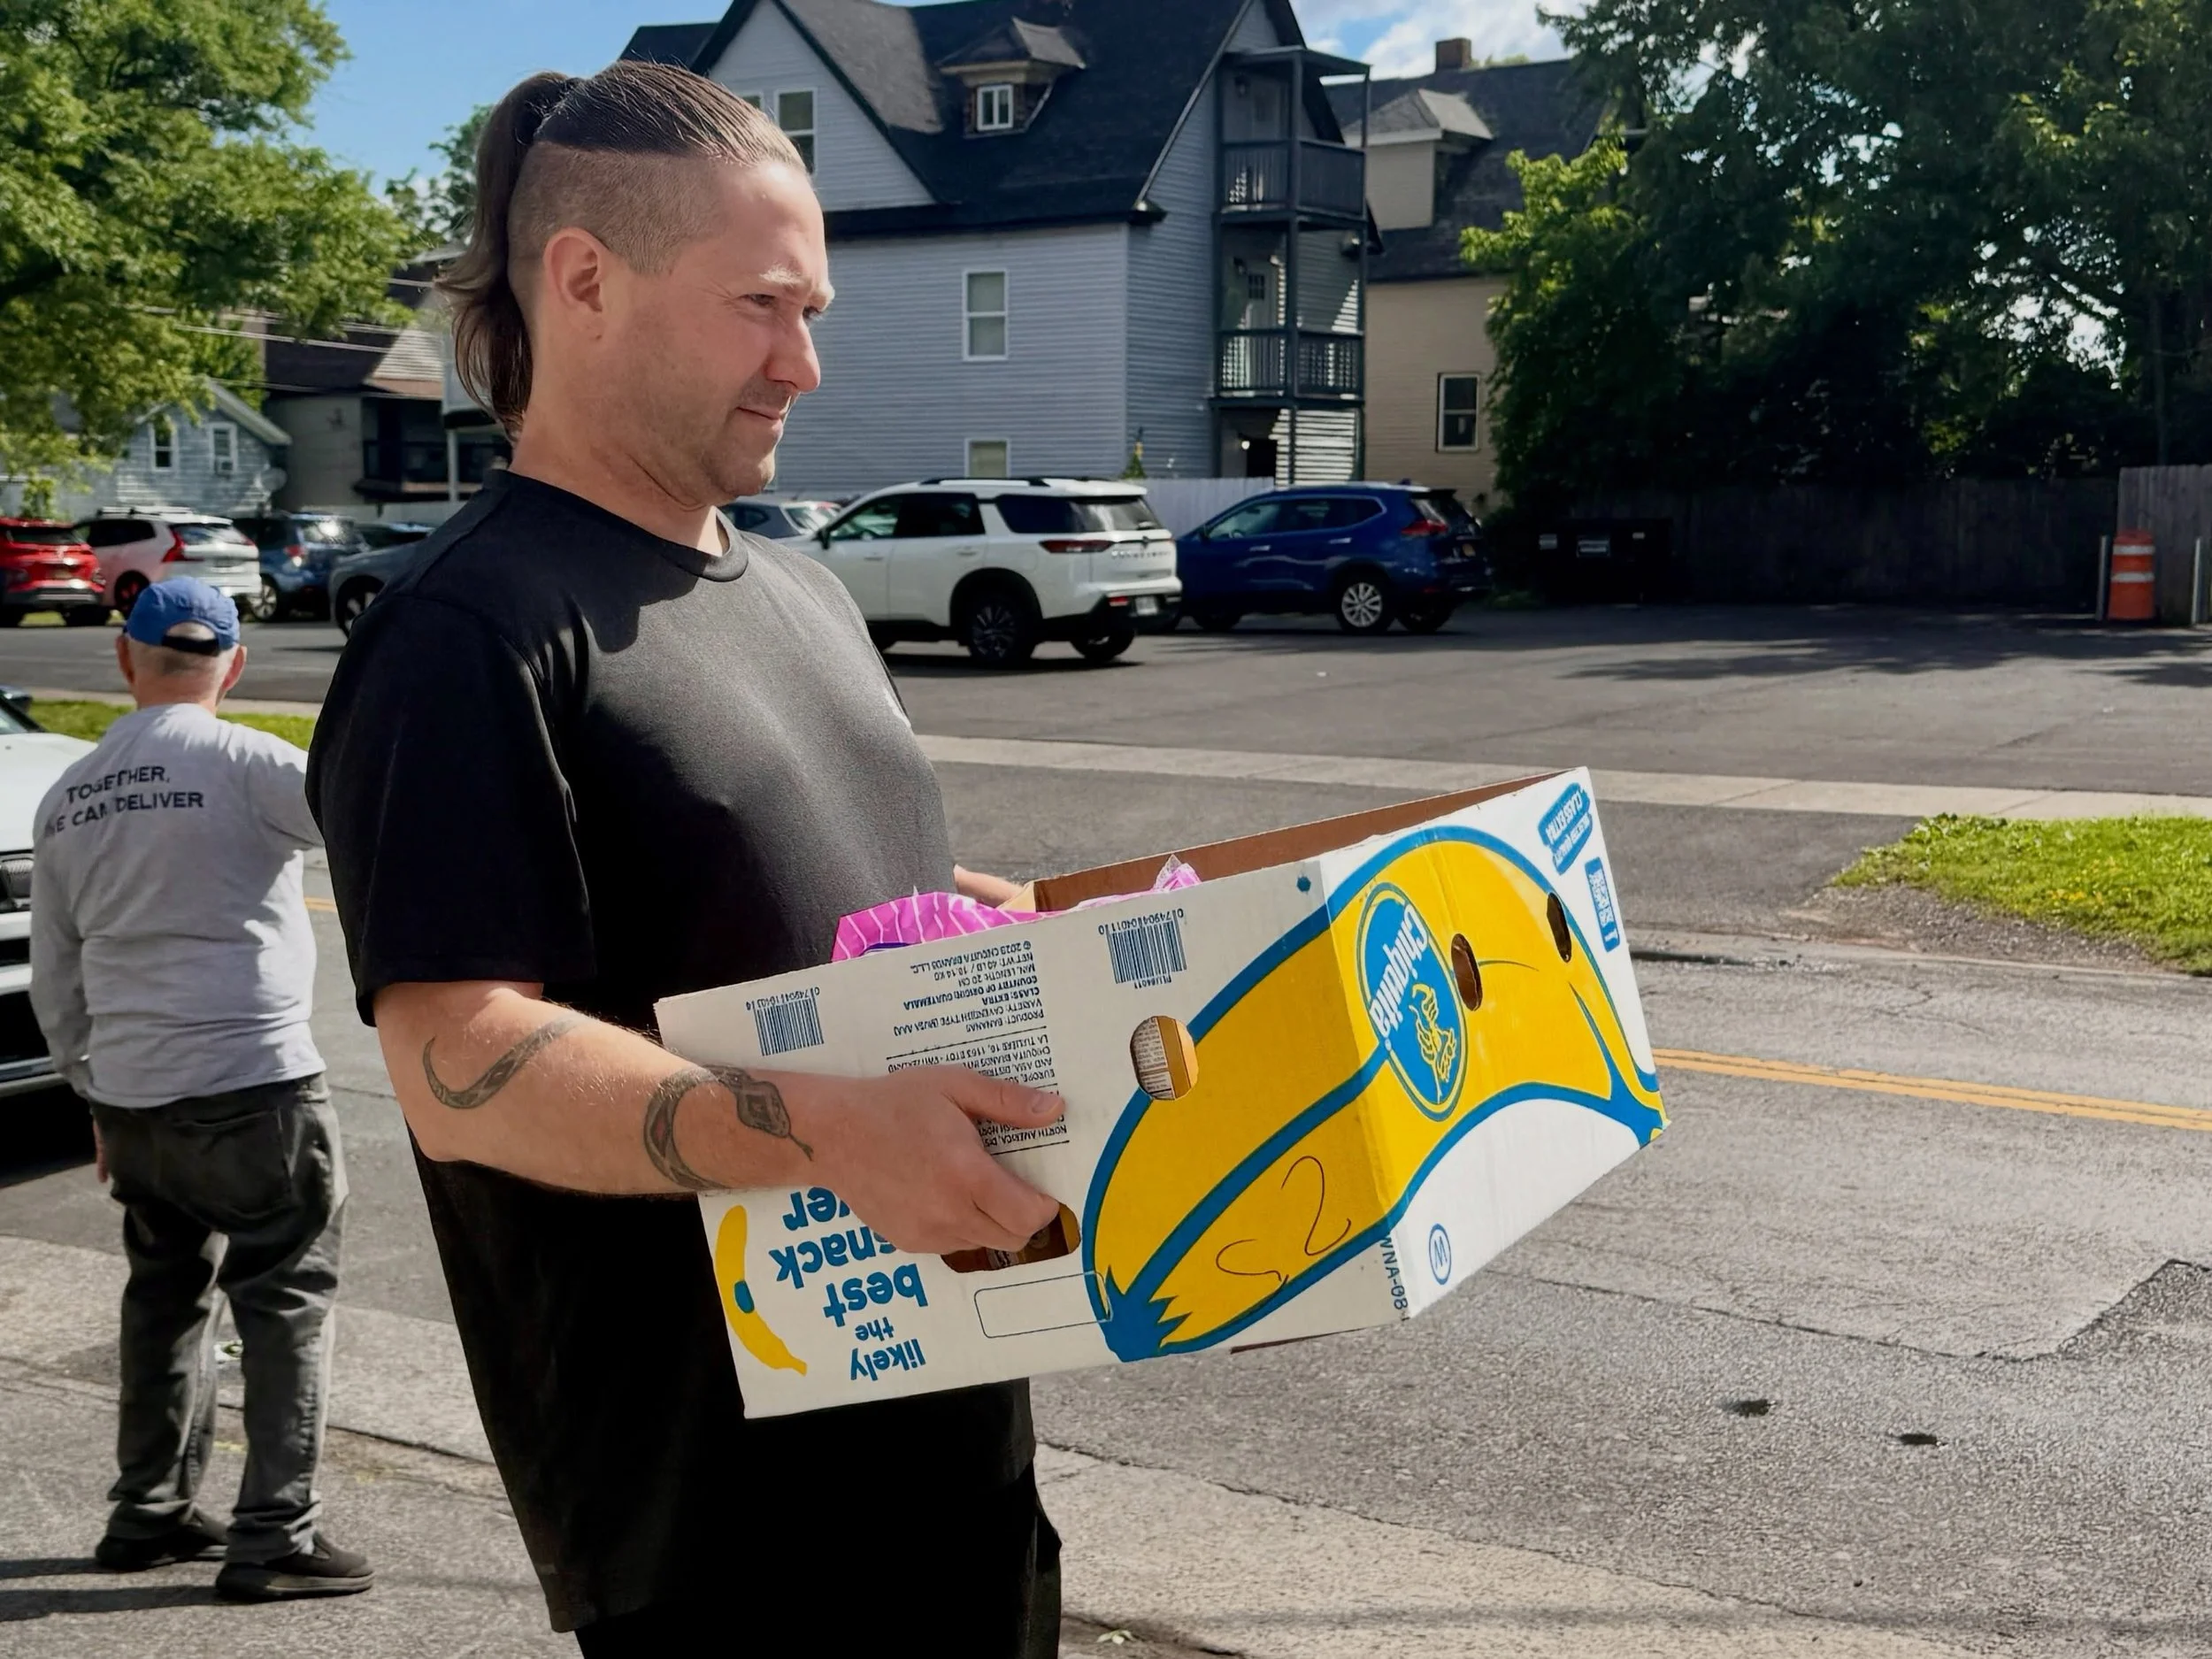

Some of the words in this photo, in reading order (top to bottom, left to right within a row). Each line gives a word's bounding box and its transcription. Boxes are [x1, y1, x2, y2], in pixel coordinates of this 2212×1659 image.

[66, 765, 170, 804] TOGETHER,
[115, 791, 204, 813] DELIVER
[972, 974, 983, 985] 20
[1370, 904, 1428, 1038] Chiquita
[998, 975, 1039, 991] COUNTRY
[902, 992, 954, 1011] GUATEMALA
[981, 993, 1010, 1007] EXTRA
[823, 1263, 928, 1327] best
[855, 1317, 894, 1341] the
[851, 1339, 926, 1381] likely
